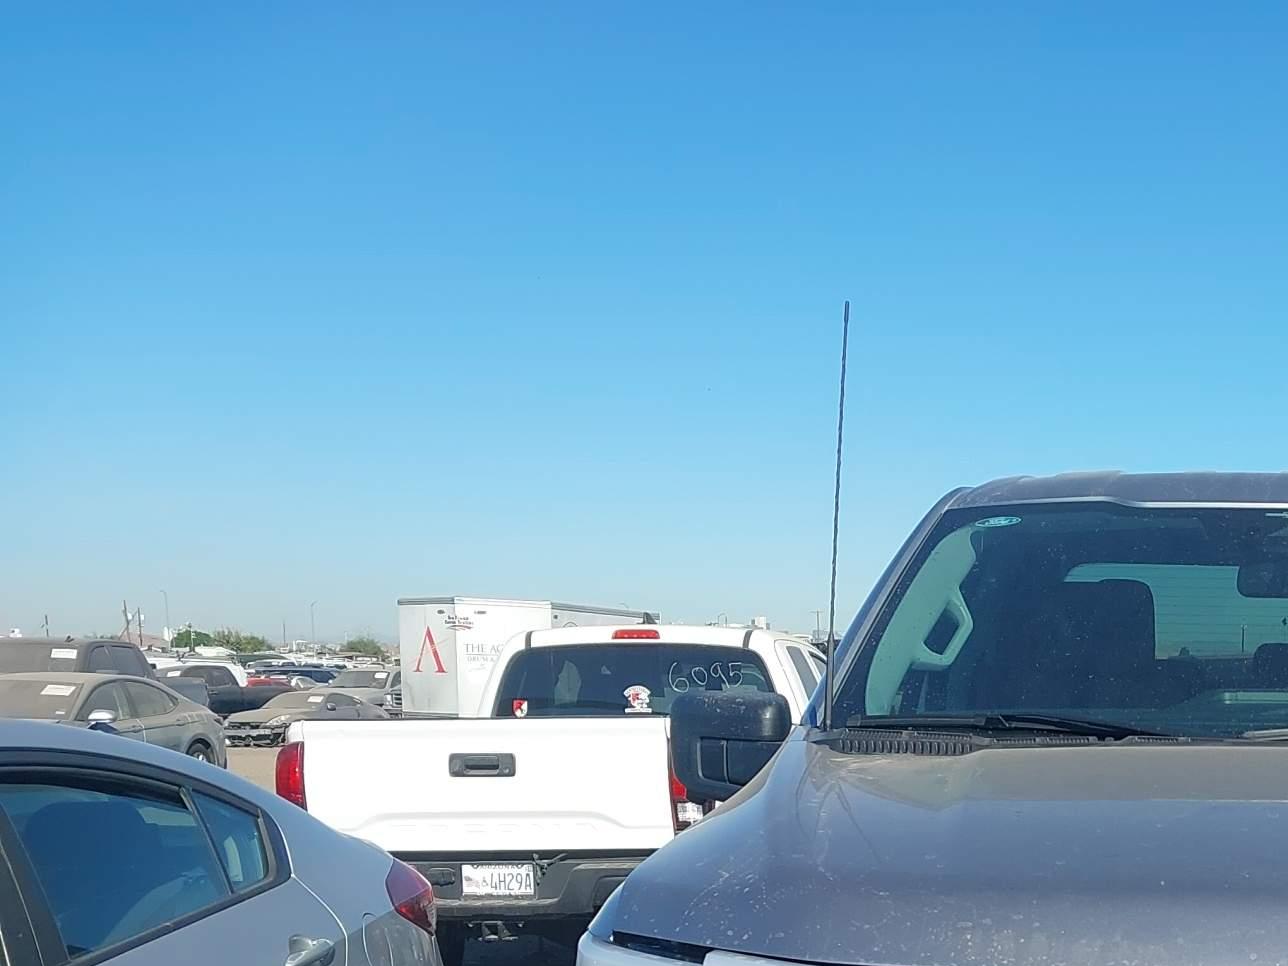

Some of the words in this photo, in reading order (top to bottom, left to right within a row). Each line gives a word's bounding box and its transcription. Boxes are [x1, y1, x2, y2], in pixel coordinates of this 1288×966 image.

[463, 643, 488, 653] THE
[668, 661, 744, 693] 6095
[490, 872, 533, 891] 4H29A
